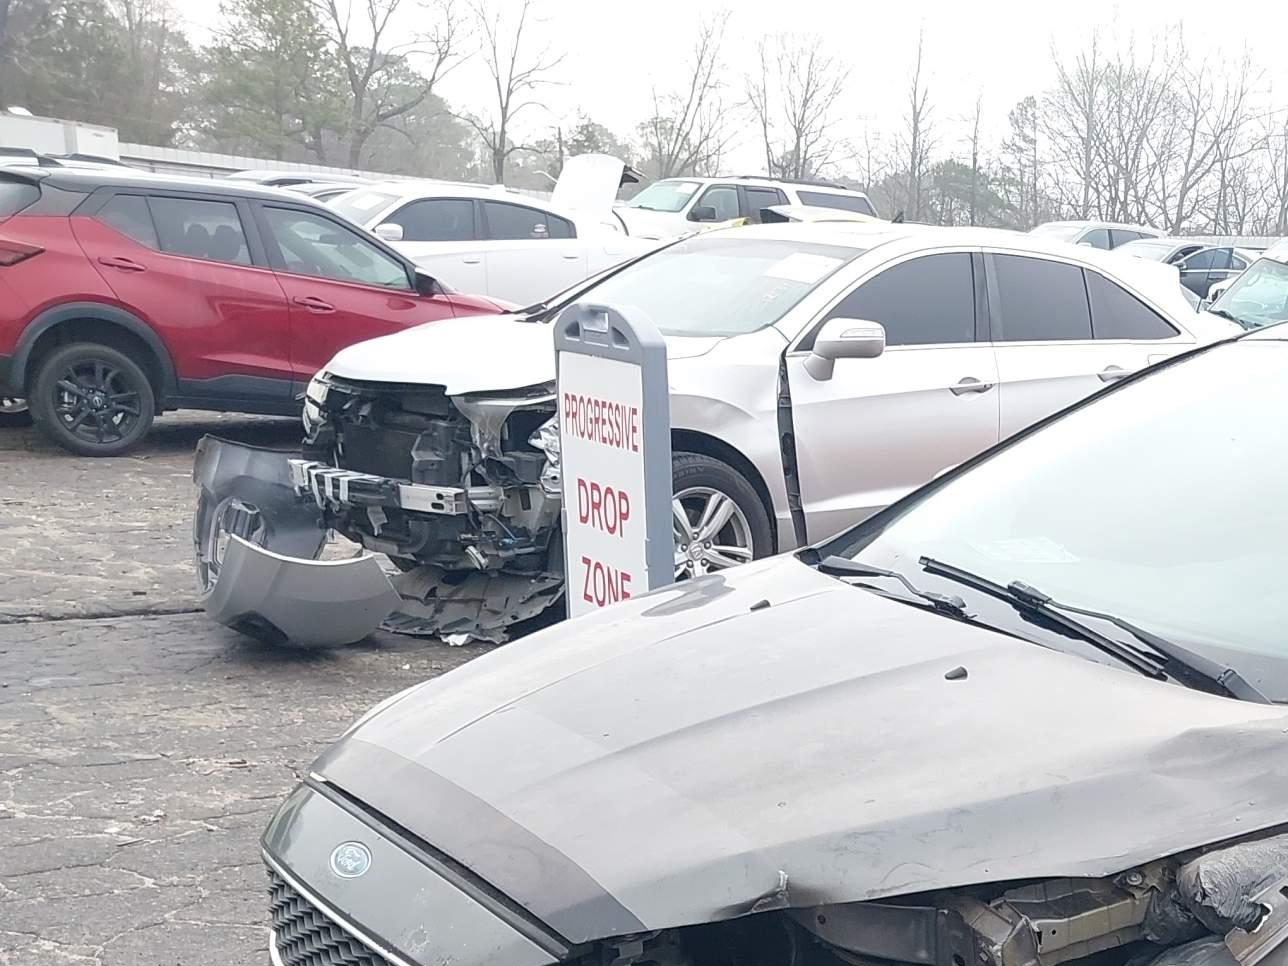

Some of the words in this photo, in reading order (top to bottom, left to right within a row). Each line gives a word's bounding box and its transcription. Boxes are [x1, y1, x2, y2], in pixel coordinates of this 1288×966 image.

[565, 393, 639, 452] PROGRESSIVE
[577, 478, 630, 538] DROP
[582, 556, 631, 607] ZONE
